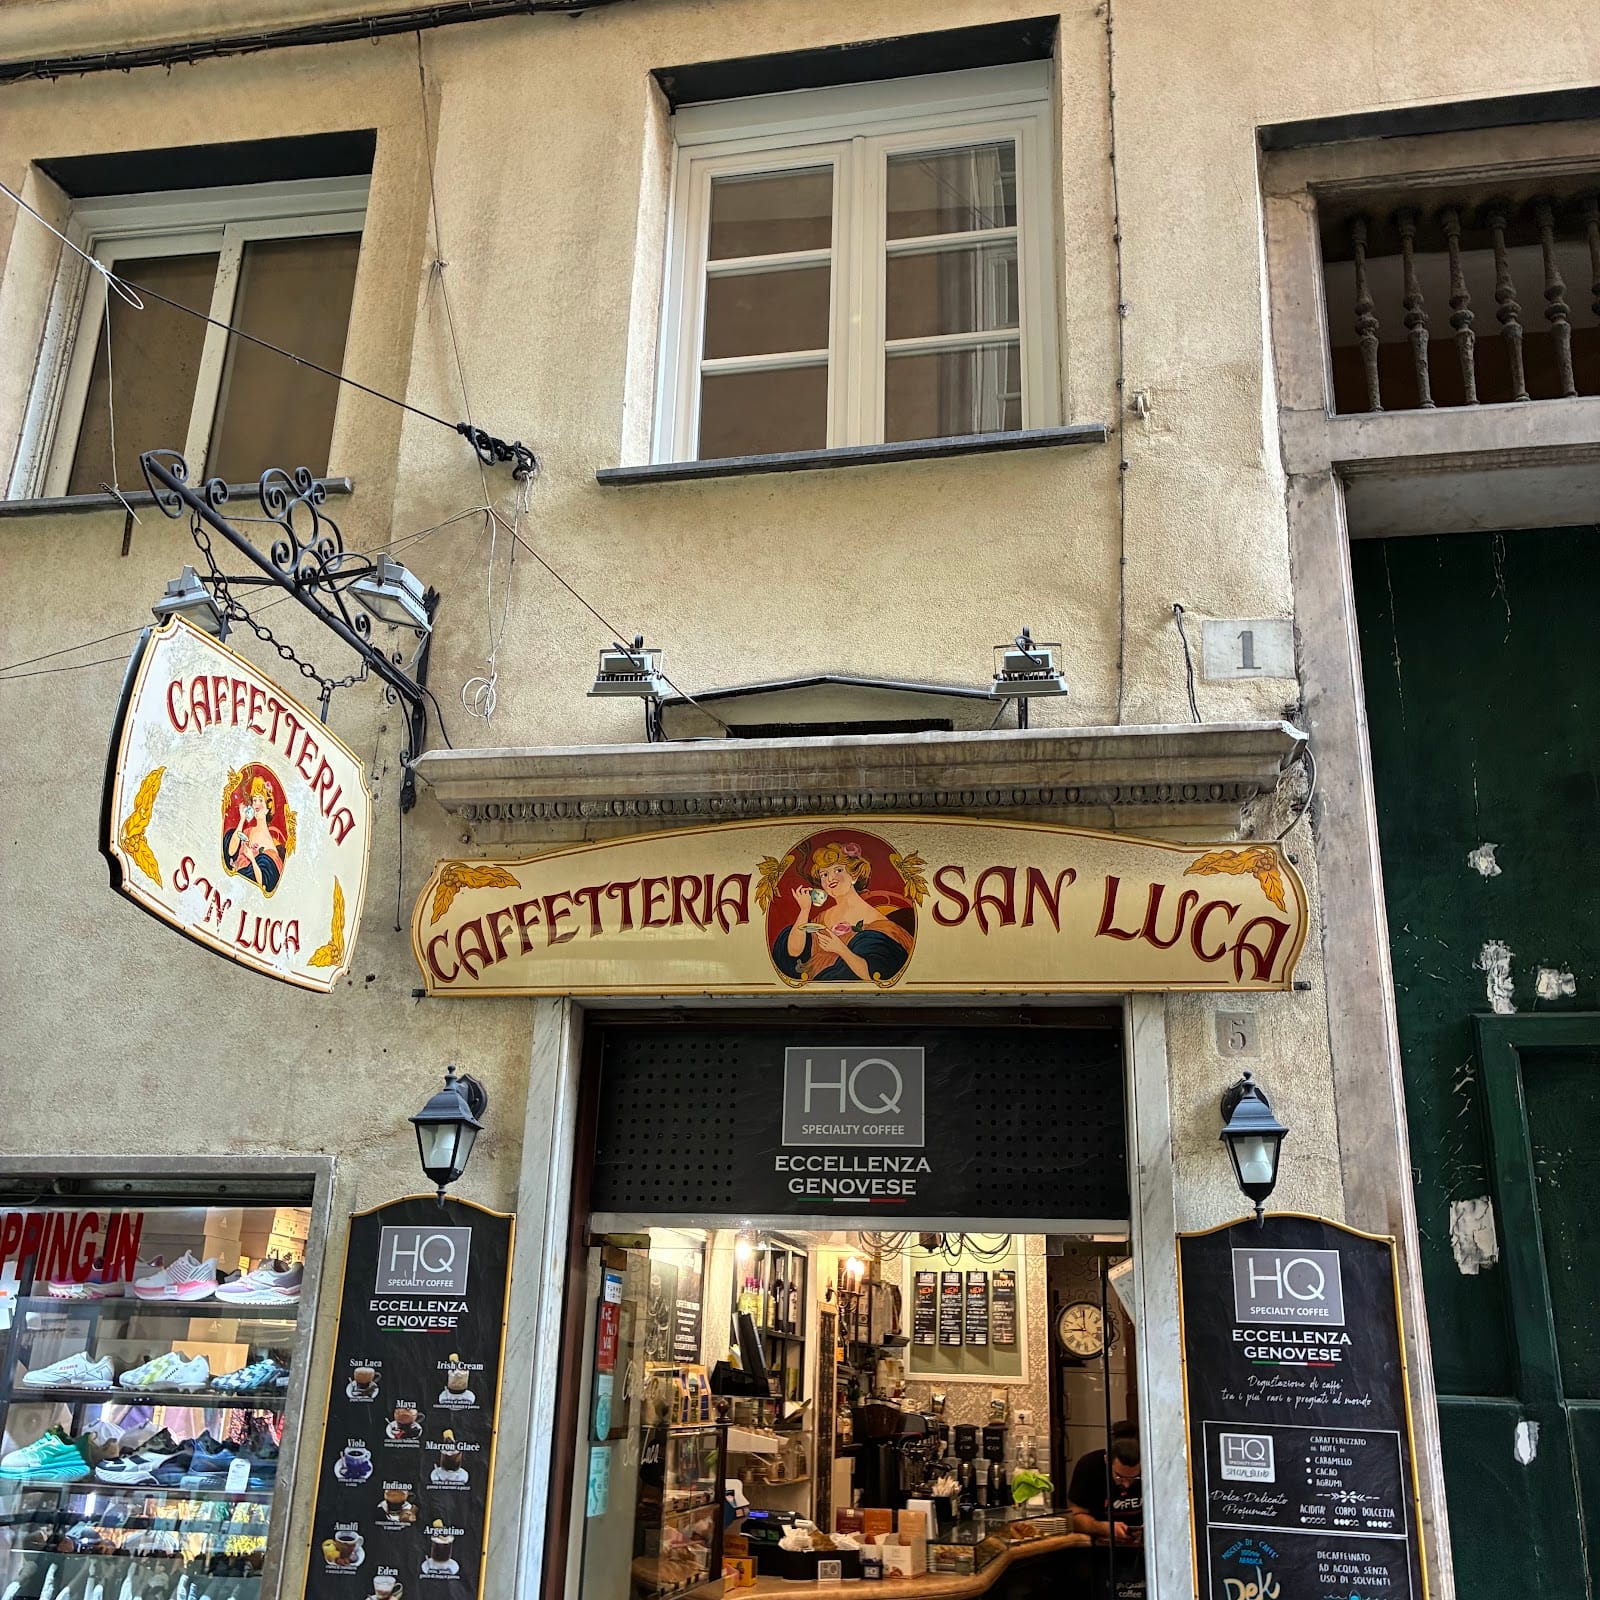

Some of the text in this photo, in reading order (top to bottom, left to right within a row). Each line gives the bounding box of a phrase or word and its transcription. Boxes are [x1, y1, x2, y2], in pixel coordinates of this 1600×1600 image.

[1237, 631, 1261, 669] 1
[167, 675, 356, 846] CAFFETTERIA
[427, 865, 1291, 983] CAFFETTERIA SAN LUCA
[235, 910, 300, 955] LUCA
[1229, 1019, 1246, 1051] 5
[804, 1058, 903, 1114] HQ
[802, 1124, 904, 1135] SPECIALTY COFFEE
[775, 1155, 932, 1173] ECCELLENZA
[788, 1178, 917, 1195] GENOVESE
[102, 1212, 144, 1282] IN
[390, 1234, 455, 1273] HQ
[388, 1279, 454, 1287] SPECIALTY COFFEE
[1248, 1258, 1325, 1300] HQ
[369, 1300, 469, 1313] ECCELLENZA
[1250, 1306, 1329, 1316] SPECIALTY COFFEE
[376, 1315, 458, 1328] GENOVESE
[1232, 1329, 1352, 1345] ECCELLENZA
[1244, 1346, 1342, 1361] GENOVESE
[350, 1359, 363, 1367] San
[437, 1361, 484, 1371] Irish Cream
[1248, 1375, 1305, 1393] Degustazione
[1310, 1376, 1318, 1390] di
[396, 1400, 417, 1409] Maya
[1221, 1388, 1235, 1400] tra
[1266, 1392, 1283, 1402] rari
[1295, 1391, 1329, 1409] pregiati
[1332, 1392, 1341, 1404] al
[1344, 1393, 1372, 1408] mondo
[347, 1439, 366, 1448] Viola
[425, 1440, 455, 1451] Marron
[1310, 1436, 1366, 1446] CARATTERIZZATO
[1228, 1438, 1265, 1460] HQ
[1319, 1445, 1336, 1453] NOTE
[1314, 1456, 1352, 1466] CARAMELLO
[1315, 1468, 1338, 1476] CACAO
[383, 1481, 412, 1490] Indiano
[1316, 1479, 1342, 1488] AGRUMI
[1243, 1491, 1288, 1505] Delicato
[1222, 1503, 1278, 1519] Profumato
[1335, 1506, 1357, 1516] CORPO
[1362, 1507, 1395, 1518] DOLCEZZA
[334, 1522, 358, 1531] Amalfi
[424, 1526, 464, 1536] Argentino
[1316, 1551, 1371, 1561] DECAFFEINATO
[377, 1566, 398, 1576] Eden
[1318, 1563, 1388, 1575] AD ACQUA SENZA
[1320, 1574, 1391, 1586] USO DI SOLVENTI
